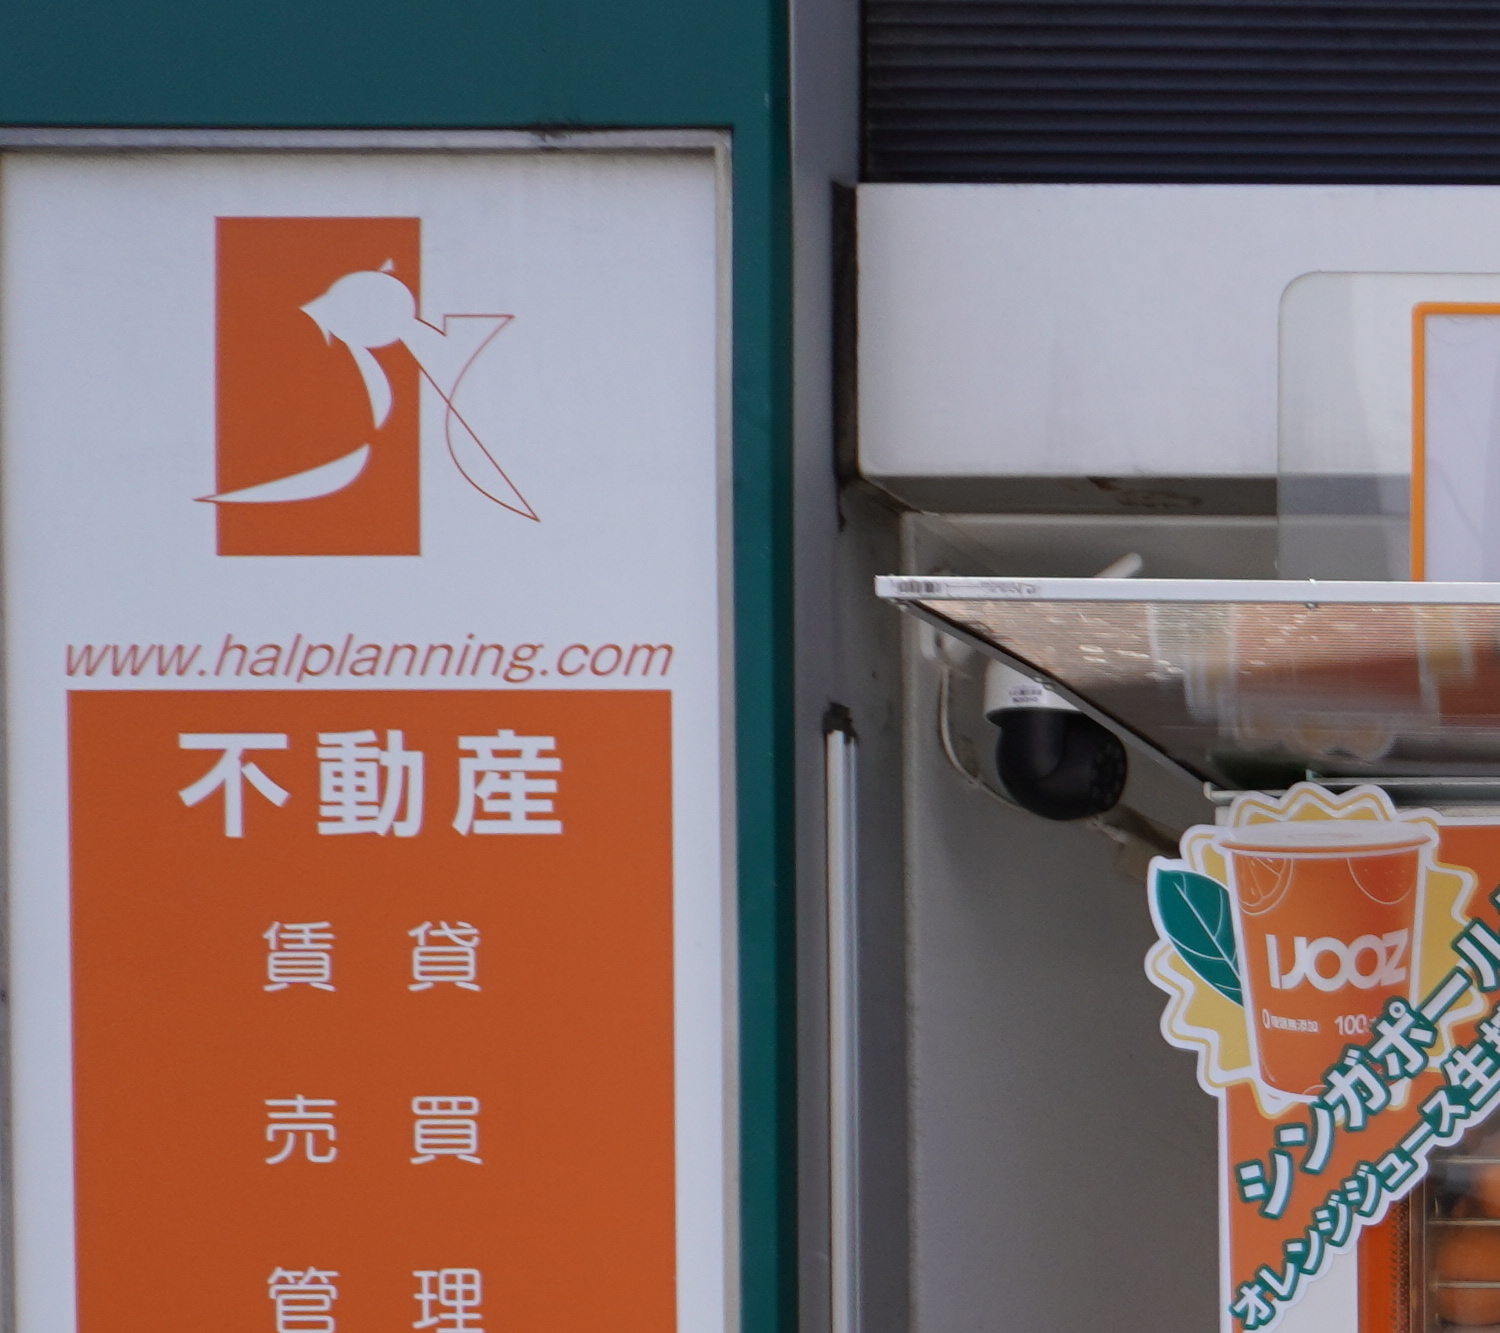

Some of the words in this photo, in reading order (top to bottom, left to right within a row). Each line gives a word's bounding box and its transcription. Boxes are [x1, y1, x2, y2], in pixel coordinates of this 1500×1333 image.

[64, 631, 672, 684] www.halplanning.com
[177, 727, 564, 840] 不動産
